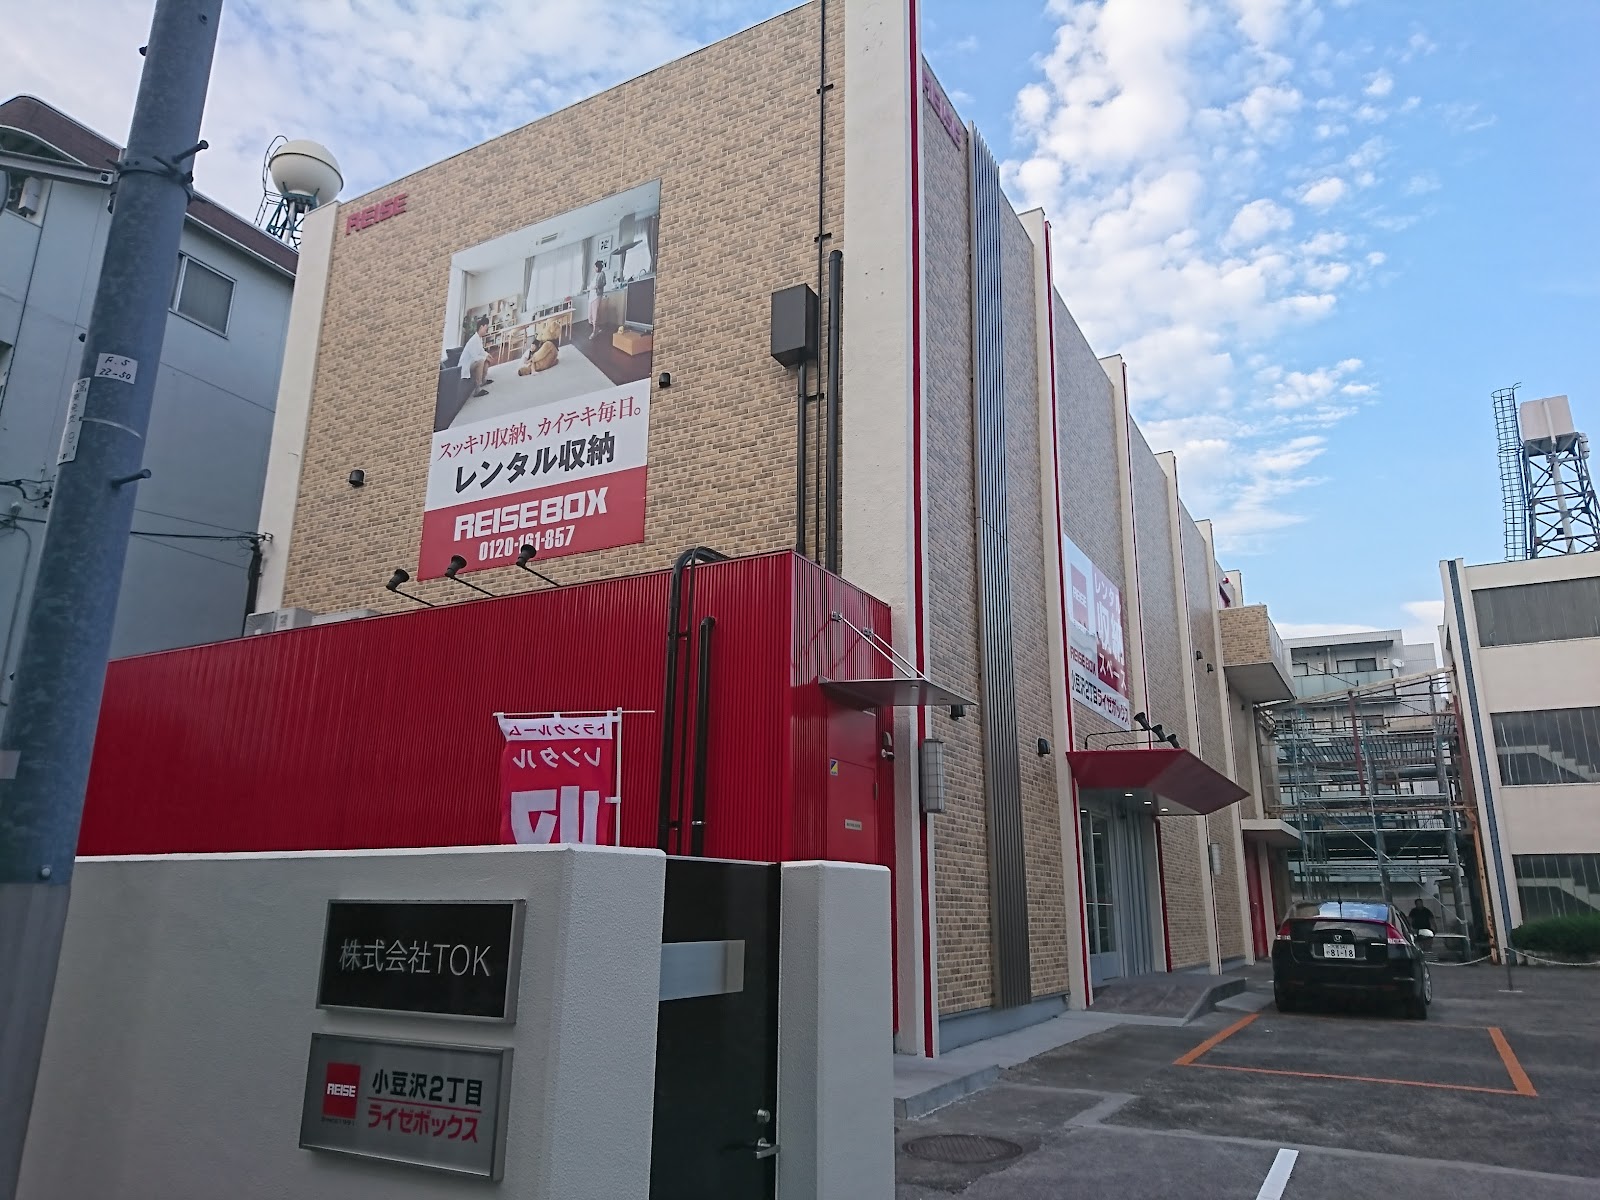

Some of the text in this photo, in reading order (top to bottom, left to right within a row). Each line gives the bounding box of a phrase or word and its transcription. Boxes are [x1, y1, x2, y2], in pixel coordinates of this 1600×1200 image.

[345, 191, 408, 236] REISE
[437, 396, 641, 461] スッキリ収納、カイテキ毎日。
[455, 430, 616, 494] レンタル収納
[1094, 572, 1121, 614] レンタル
[1096, 601, 1124, 666] 収納
[1099, 652, 1127, 691] スペース
[339, 938, 492, 977] 株式会社TOK
[326, 1083, 356, 1097] REISE
[372, 1069, 483, 1107] 小豆沢2丁目
[367, 1104, 478, 1143] ライゼボックス
